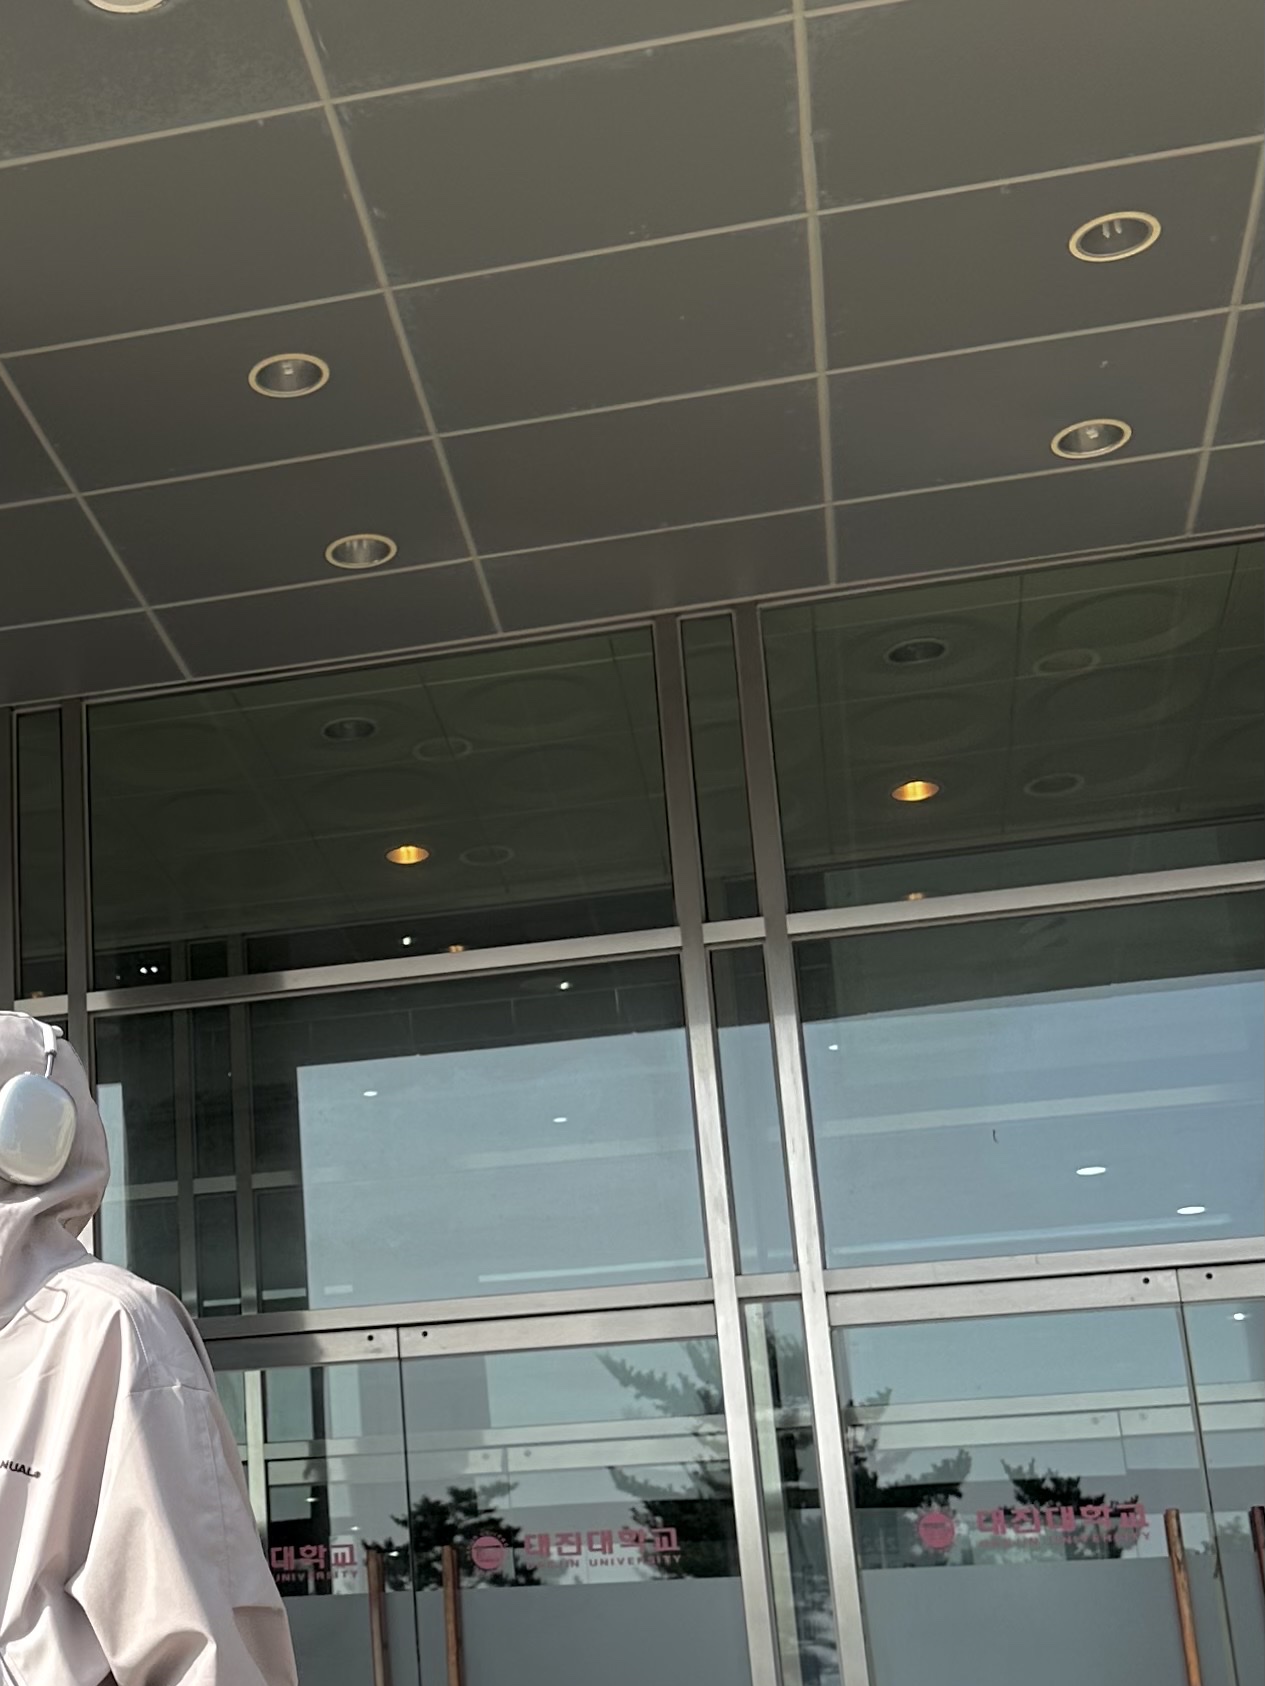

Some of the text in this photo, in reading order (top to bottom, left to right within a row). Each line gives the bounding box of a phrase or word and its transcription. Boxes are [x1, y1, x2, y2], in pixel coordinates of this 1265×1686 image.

[976, 1503, 1149, 1536] 대진대학교
[524, 1526, 681, 1557] 대진대학교
[589, 1555, 681, 1567] UNIVERSITY
